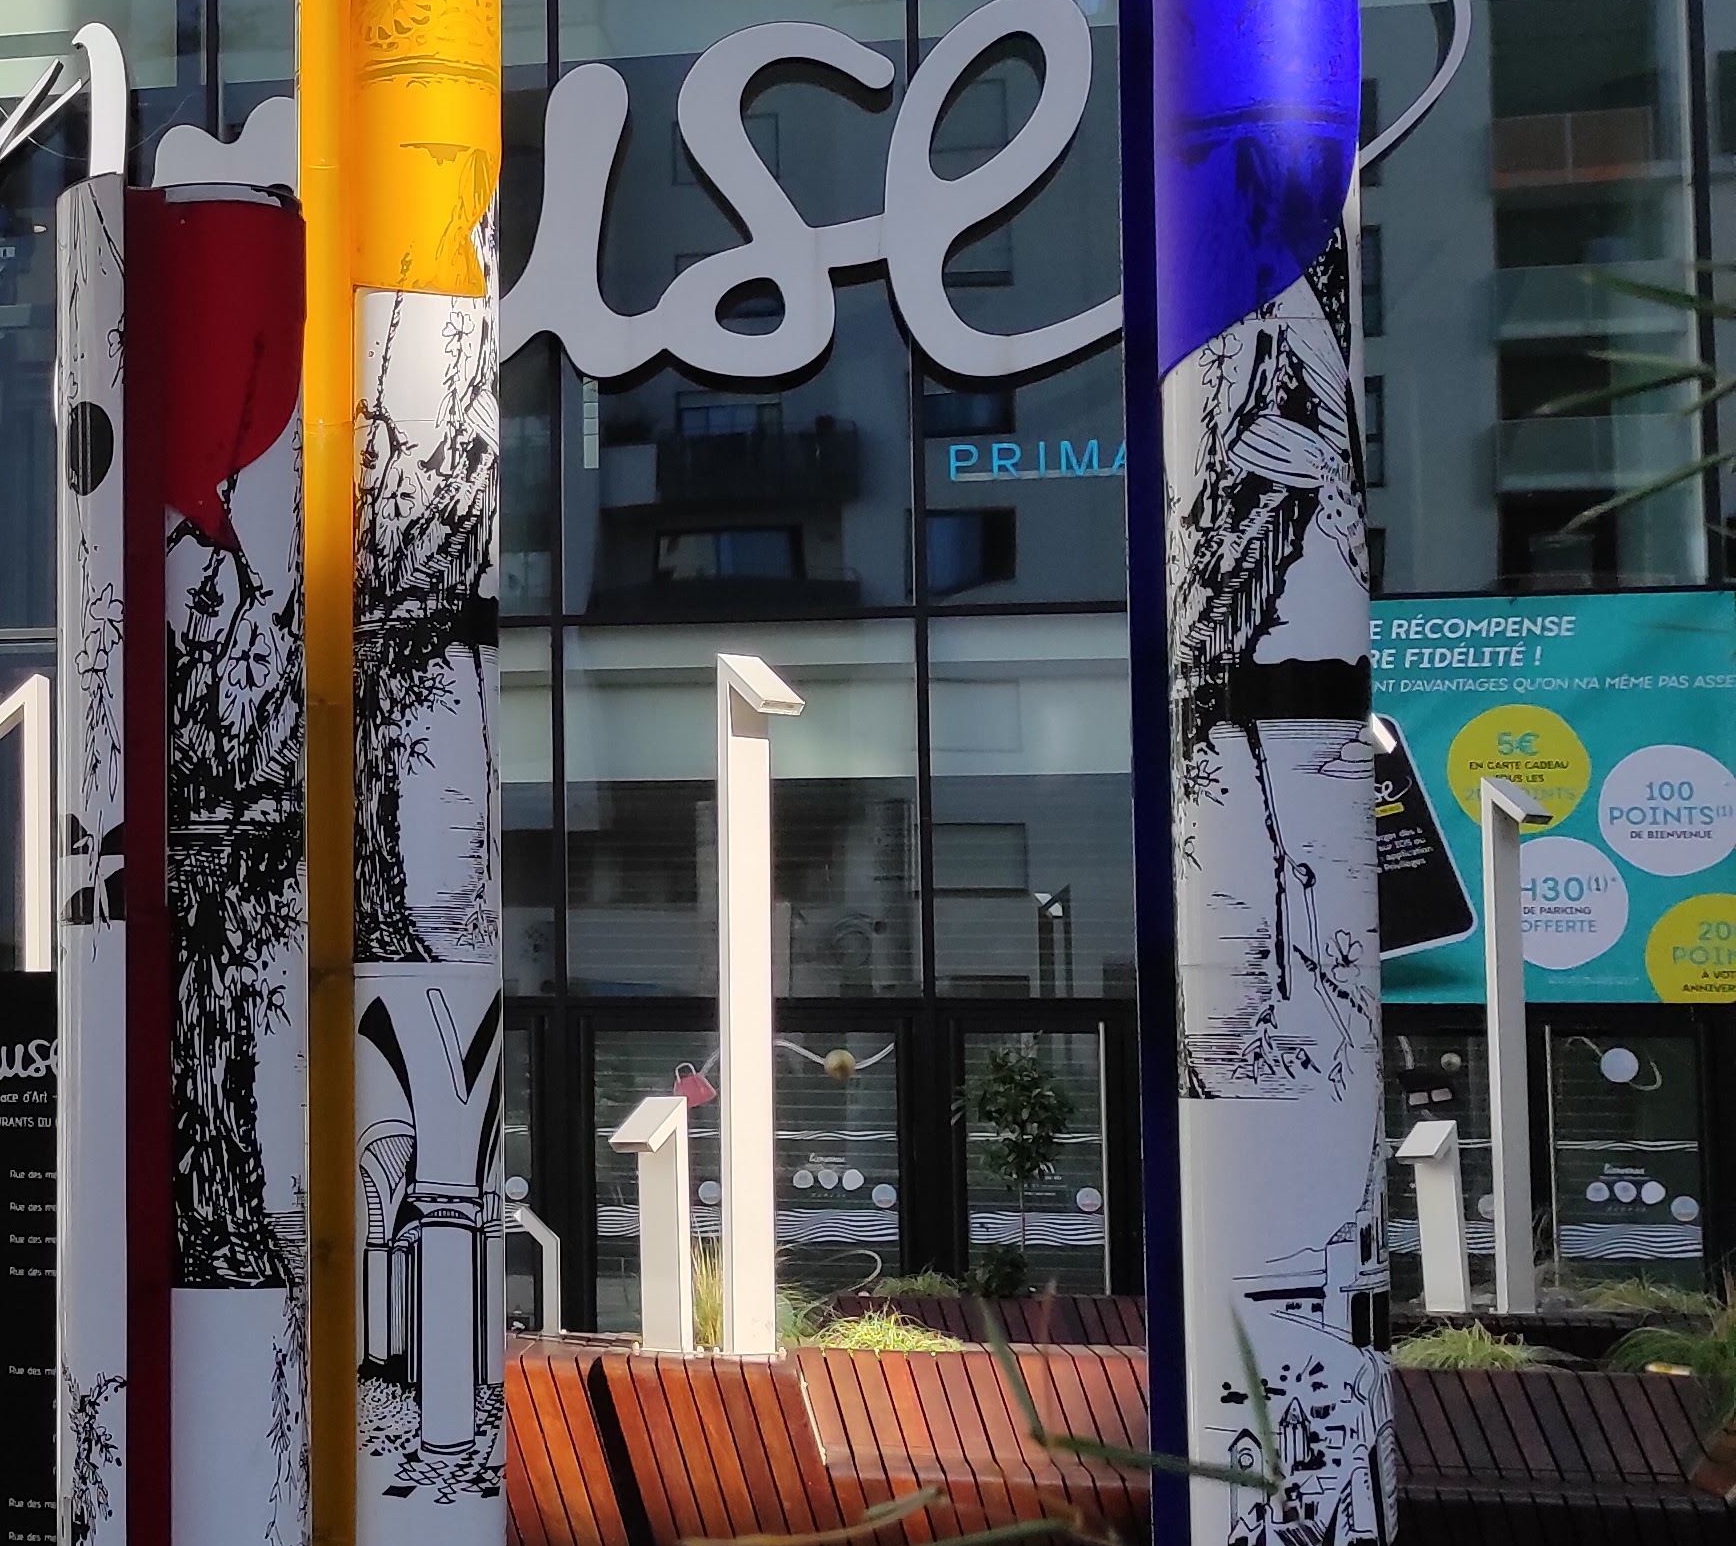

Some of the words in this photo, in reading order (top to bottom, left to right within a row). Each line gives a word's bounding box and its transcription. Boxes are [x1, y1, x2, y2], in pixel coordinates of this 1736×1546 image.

[1391, 614, 1576, 640] RÉCOMPENSE
[1404, 640, 1527, 669] FIDÉLITÉ
[1400, 677, 1508, 693] D'AVANTAGES
[1513, 677, 1569, 694] QU'ON
[1605, 673, 1653, 689] MÊME
[1658, 675, 1689, 688] PAS
[1497, 732, 1539, 756] 5€
[1469, 761, 1483, 770] EN
[1525, 761, 1569, 769] CADEAU
[1526, 774, 1544, 782] LES
[1646, 781, 1694, 801] 100
[1630, 830, 1643, 839] DE
[1648, 830, 1712, 839] BIENVENUE
[1523, 906, 1536, 915] DE
[1540, 906, 1592, 915] PARKING
[37, 1117, 52, 1128] DU
